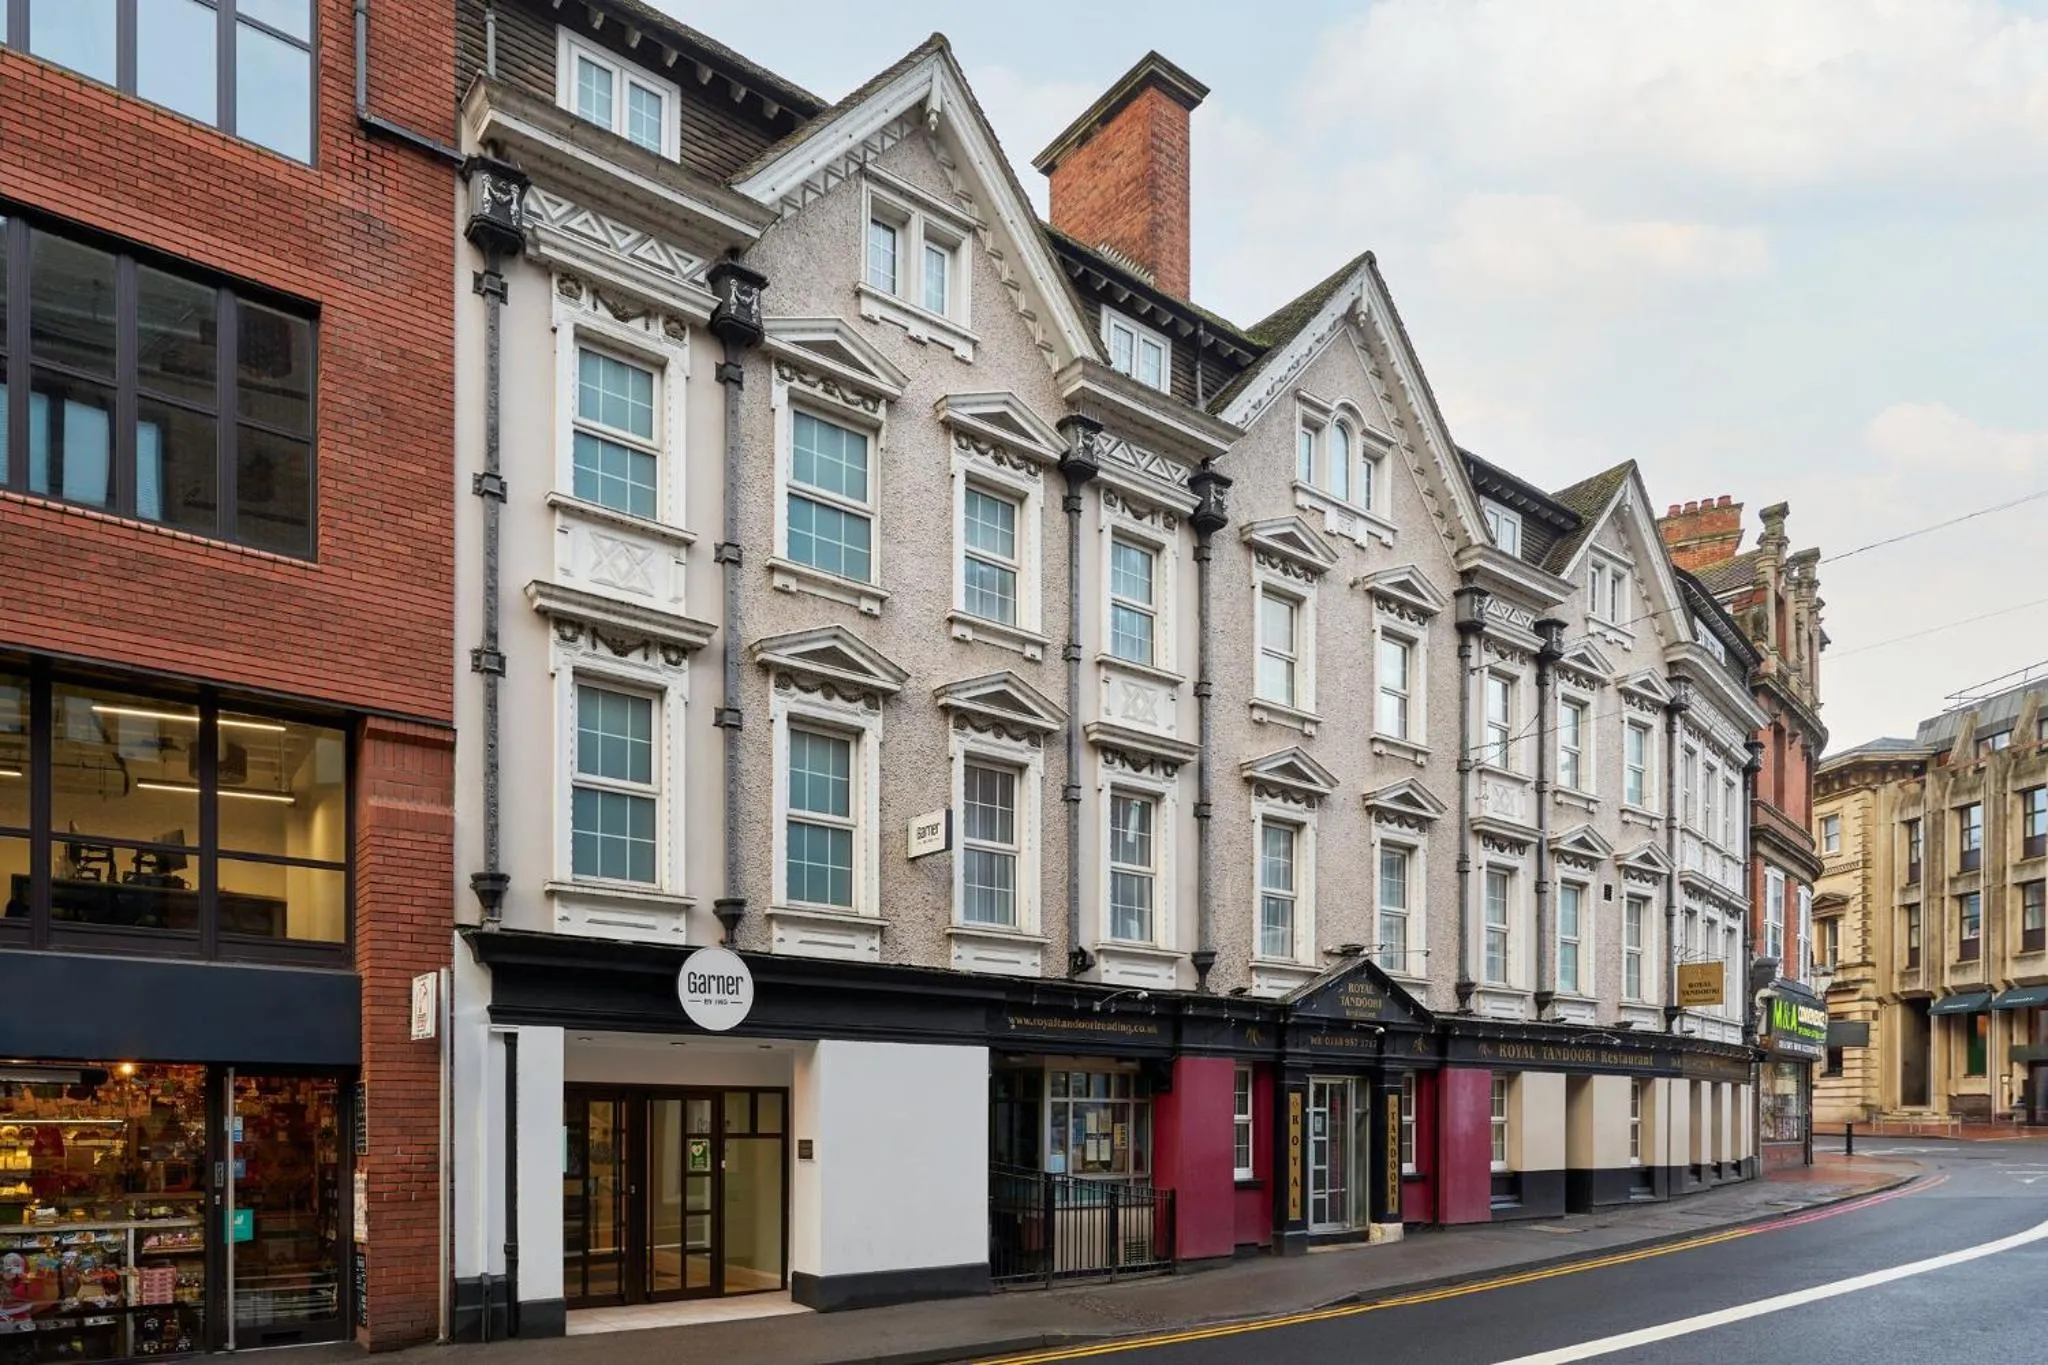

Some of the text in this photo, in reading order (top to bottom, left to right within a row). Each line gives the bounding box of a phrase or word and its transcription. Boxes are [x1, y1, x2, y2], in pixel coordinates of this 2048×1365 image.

[687, 971, 744, 995] Garner
[1348, 983, 1376, 995] ROYAL
[1339, 996, 1383, 1010] TANDOORI
[1773, 999, 1798, 1031] M&A
[1500, 1043, 1654, 1066] ROYAL TANDOORI Restaurant
[1291, 1114, 1299, 1208] ROYAL
[1389, 1111, 1397, 1208] TANDOORI
